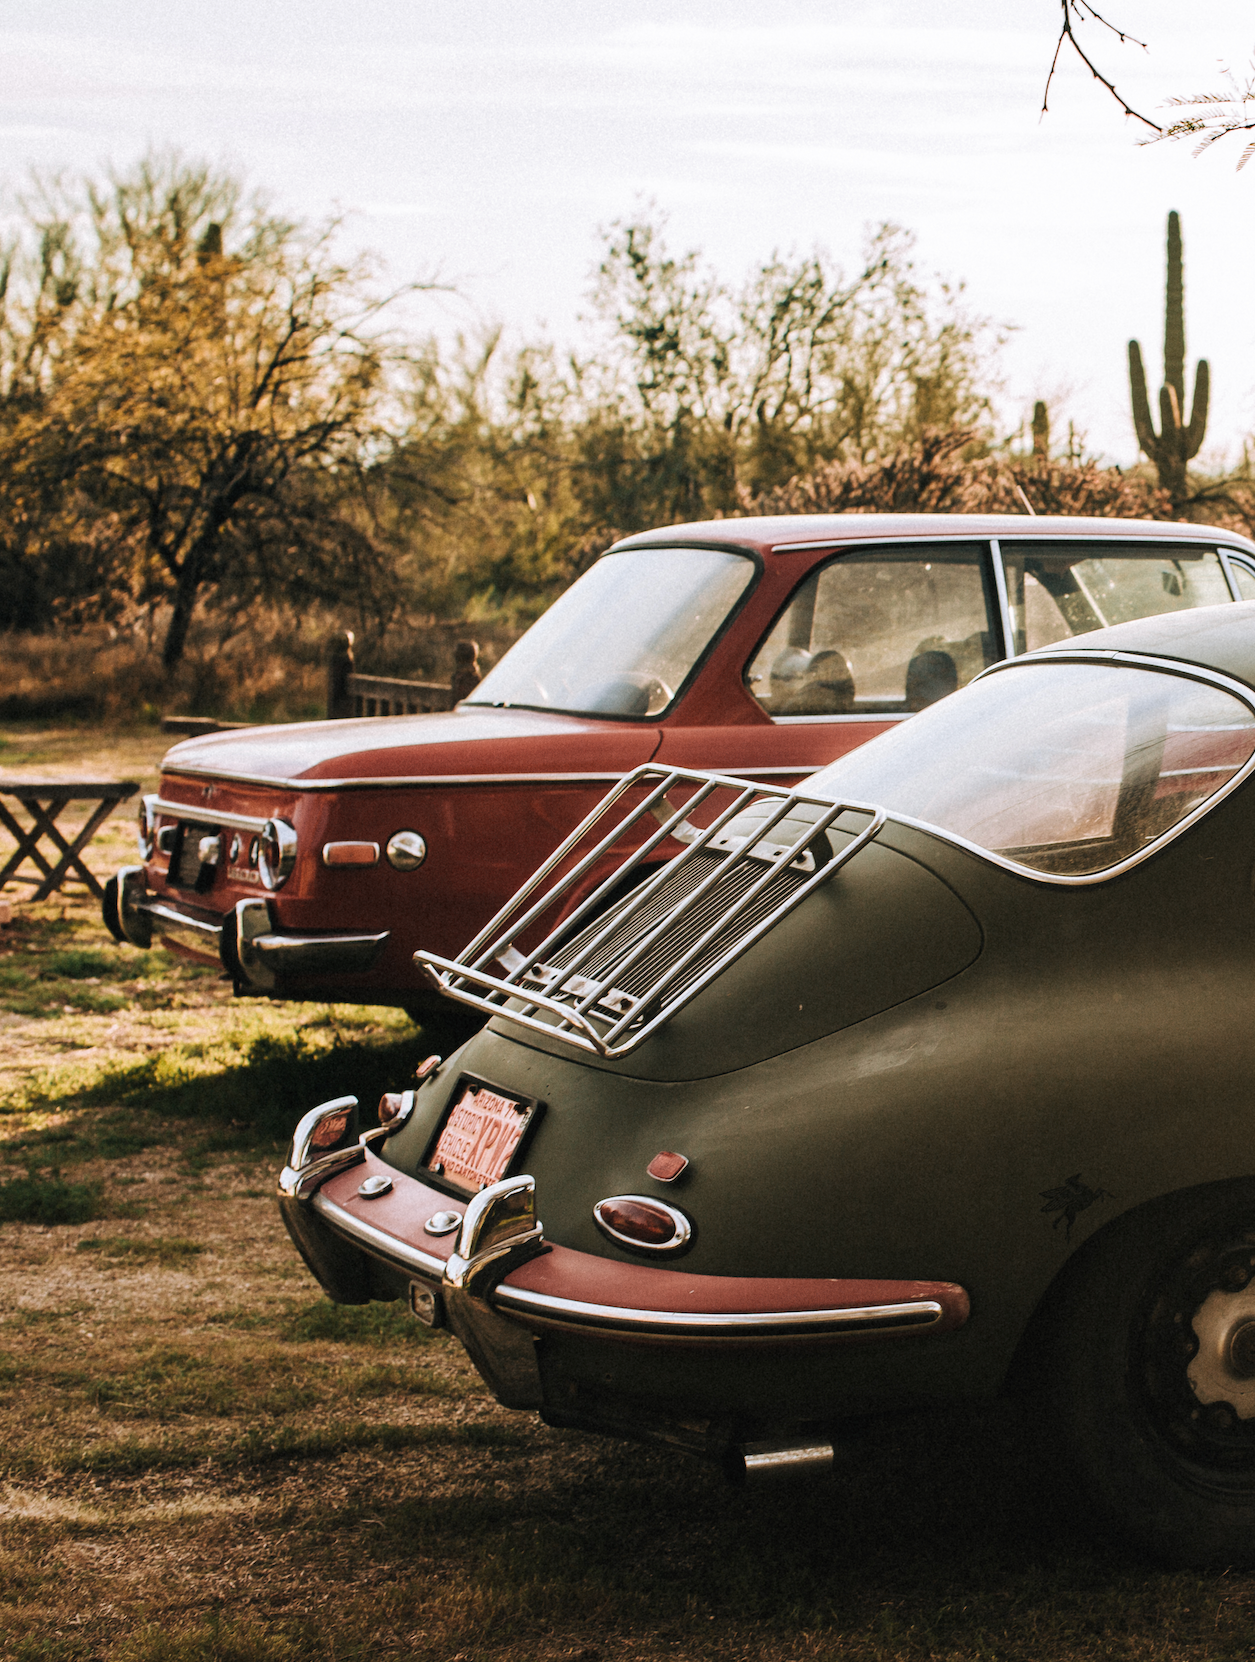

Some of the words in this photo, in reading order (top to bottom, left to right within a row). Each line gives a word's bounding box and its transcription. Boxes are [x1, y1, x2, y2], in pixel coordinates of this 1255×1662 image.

[473, 1091, 505, 1113] ARIZONA
[447, 1104, 483, 1135] HISTORIC
[436, 1129, 471, 1161] VEHICLE
